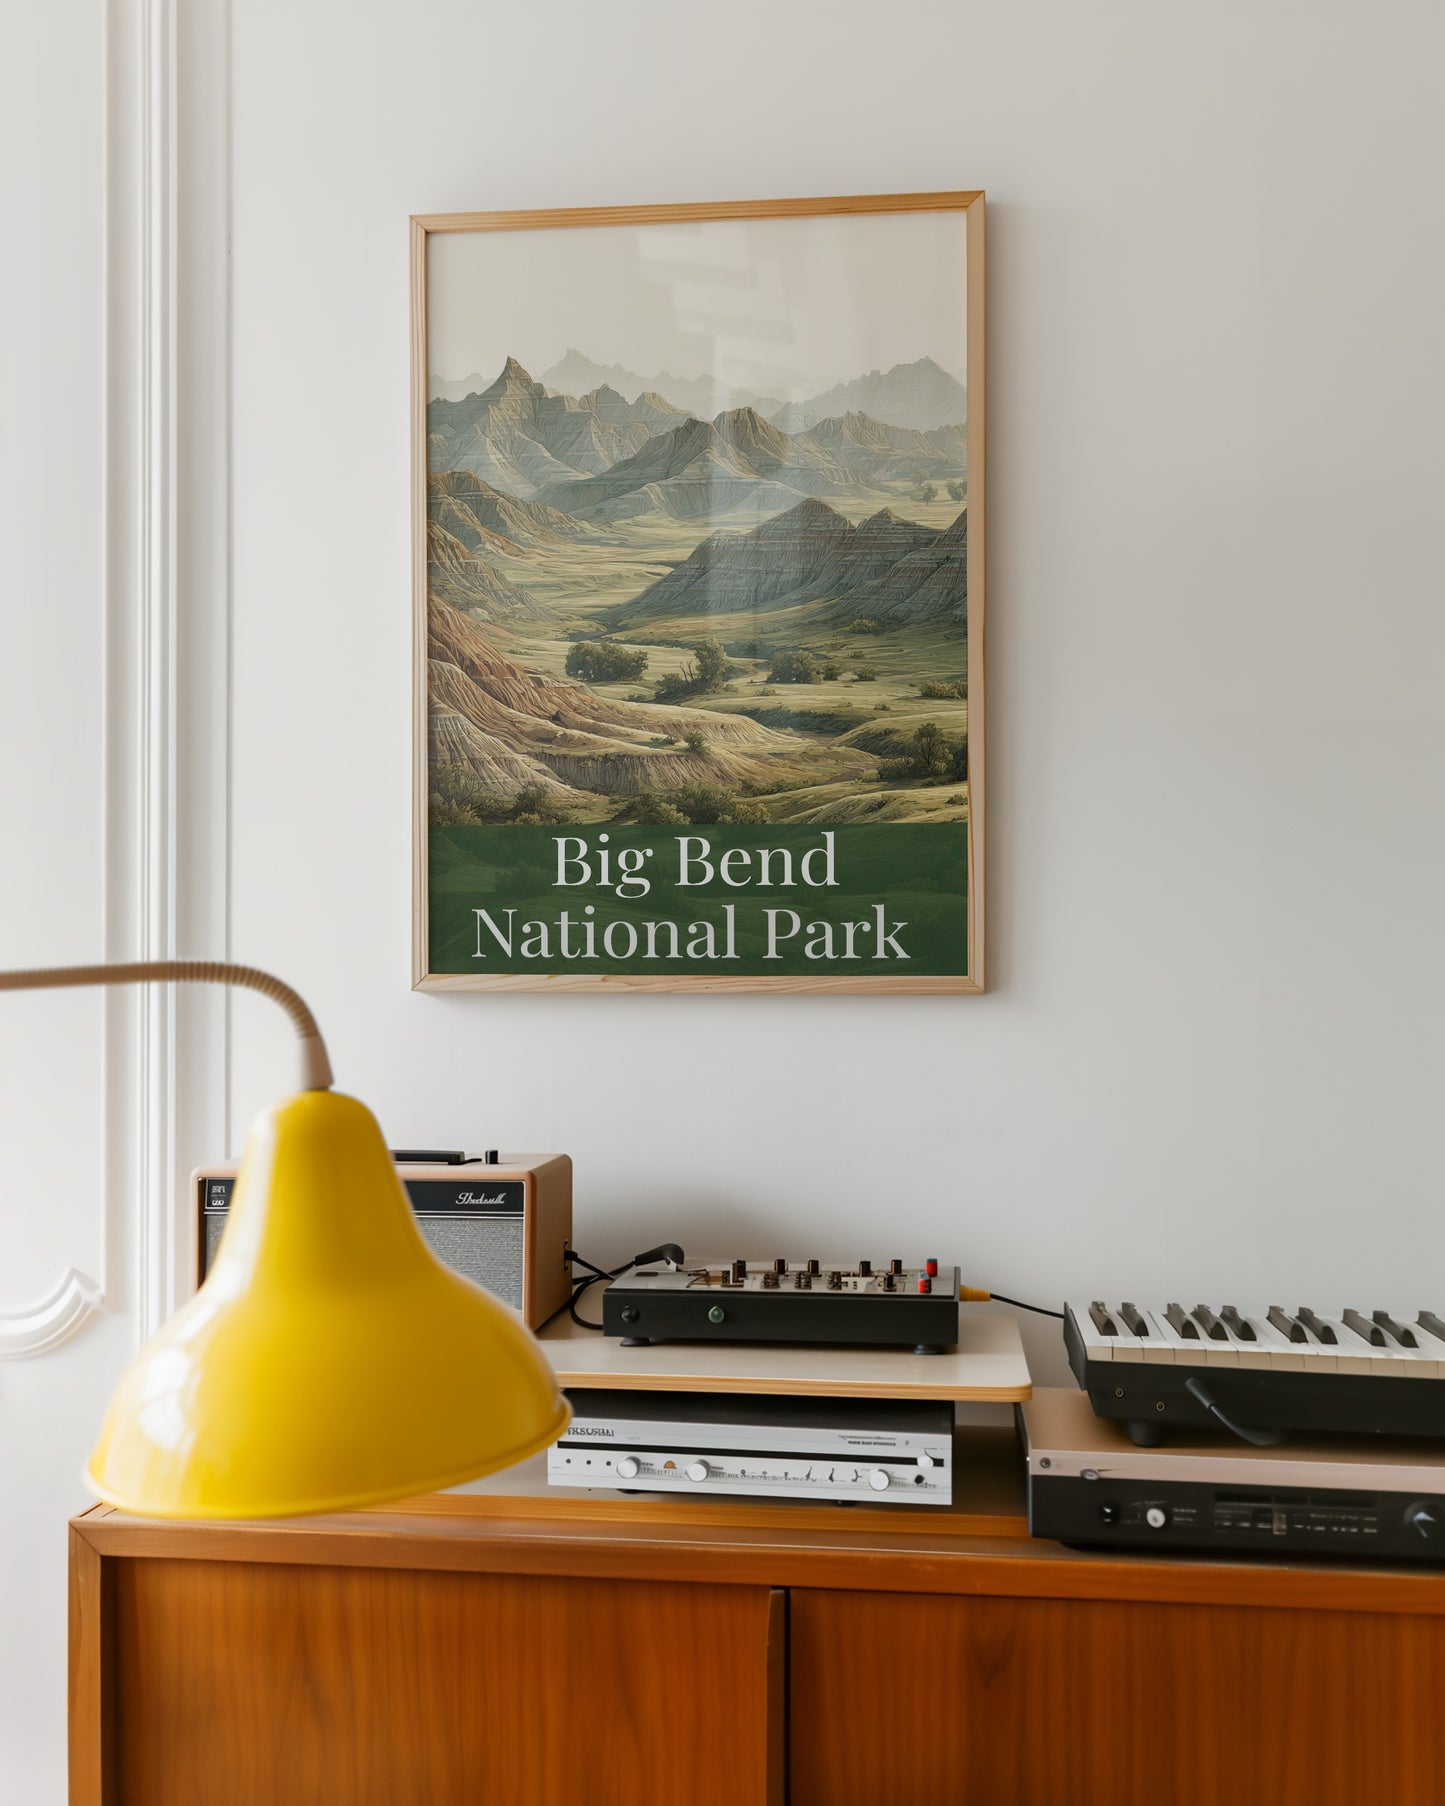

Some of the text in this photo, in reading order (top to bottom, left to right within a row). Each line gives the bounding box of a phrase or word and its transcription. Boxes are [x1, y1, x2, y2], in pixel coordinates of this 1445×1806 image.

[551, 830, 840, 899] Big Bend
[471, 903, 911, 959] National Park
